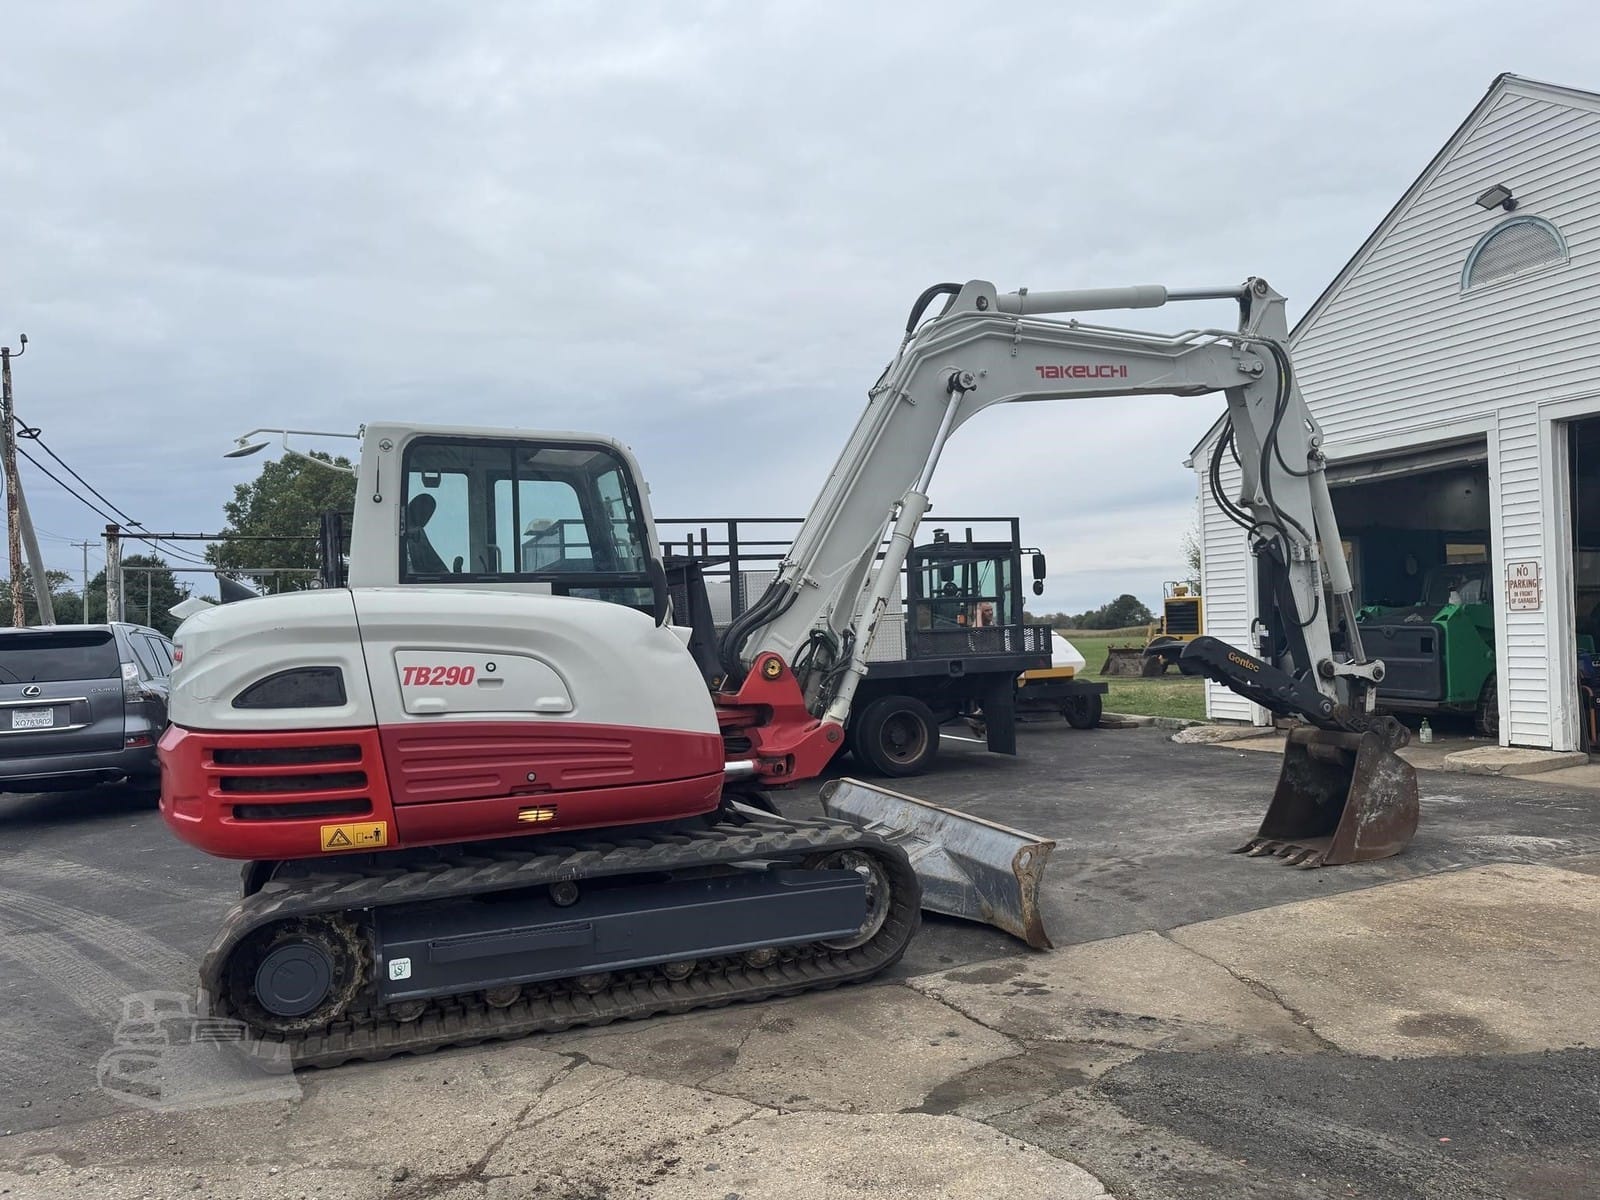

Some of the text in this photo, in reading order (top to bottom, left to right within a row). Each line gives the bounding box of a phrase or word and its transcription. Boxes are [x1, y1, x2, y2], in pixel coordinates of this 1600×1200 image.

[1516, 567, 1529, 577] NO
[1510, 578, 1537, 589] PARKING
[403, 666, 475, 686] TB290
